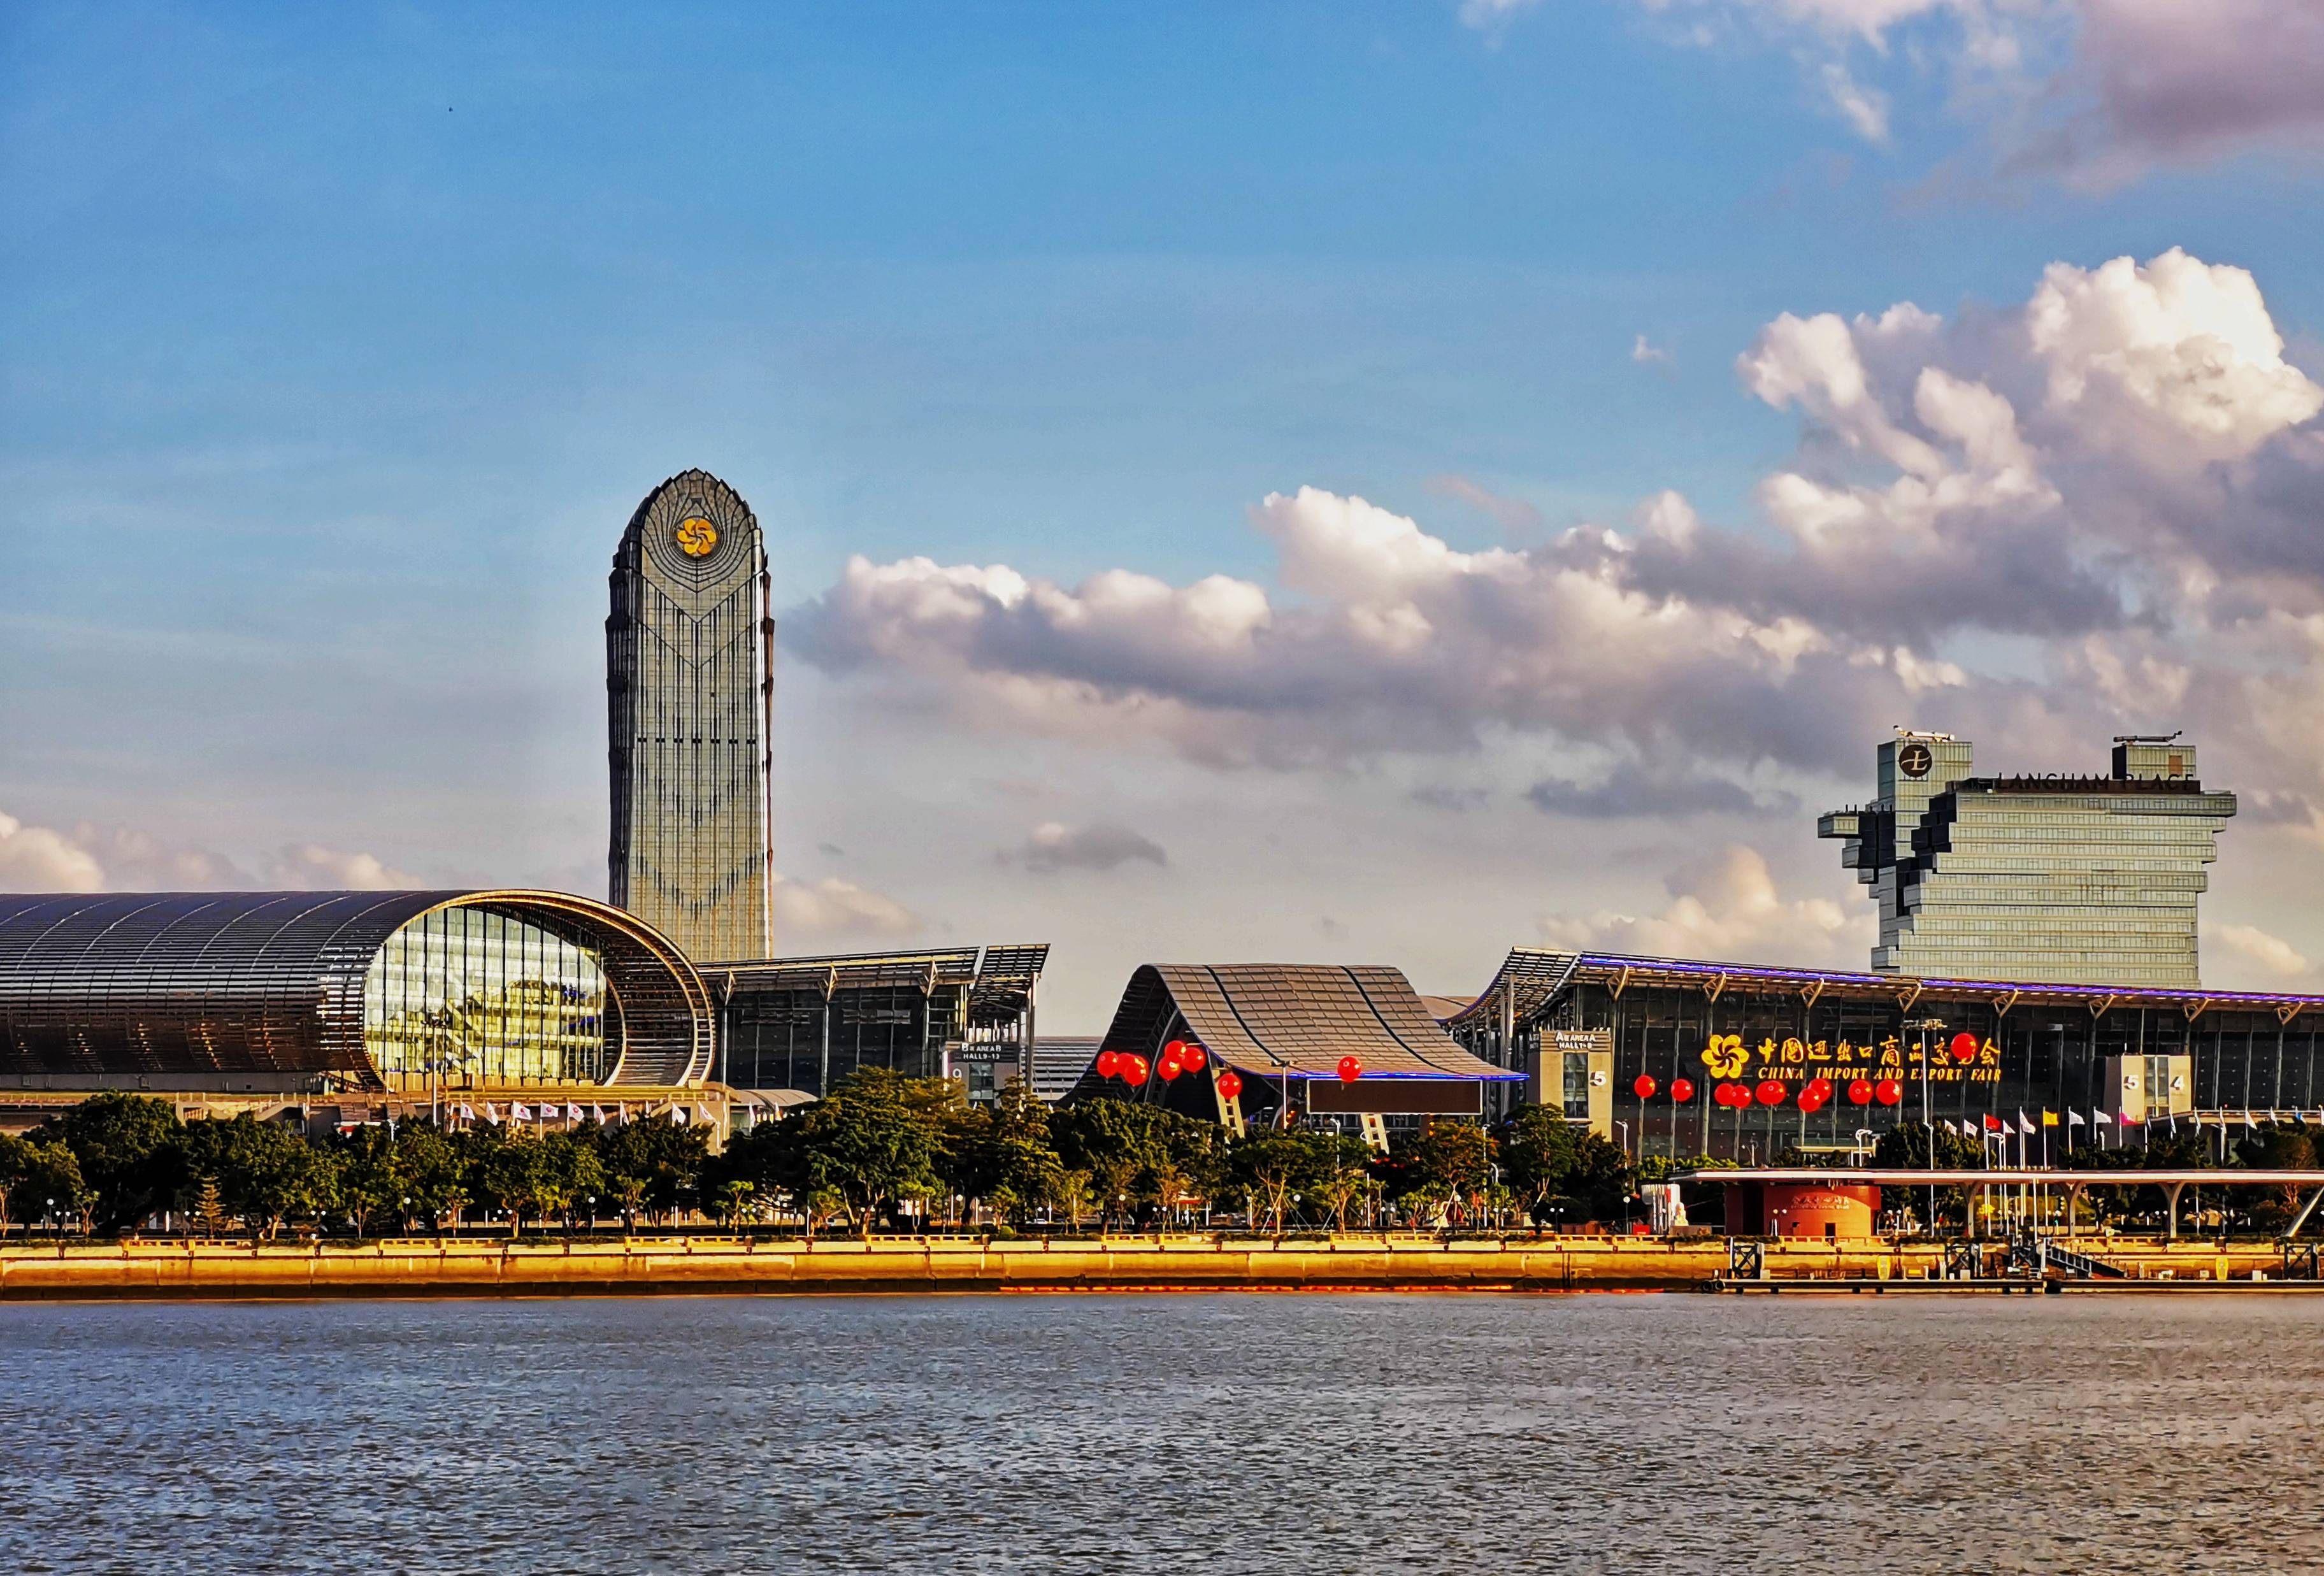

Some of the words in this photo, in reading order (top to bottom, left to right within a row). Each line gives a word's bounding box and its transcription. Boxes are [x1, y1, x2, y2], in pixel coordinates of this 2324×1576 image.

[1995, 771, 2110, 791] LANGHAM
[2121, 773, 2195, 791] PLACE
[1590, 1070, 1607, 1087] 5
[1758, 1067, 1804, 1079] CHINA
[1816, 1067, 1869, 1079] IMPORT
[1873, 1068, 1905, 1080] AND
[1970, 1068, 2002, 1081] FAIR
[2123, 1075, 2139, 1090] 5
[2170, 1075, 2185, 1090] 4
